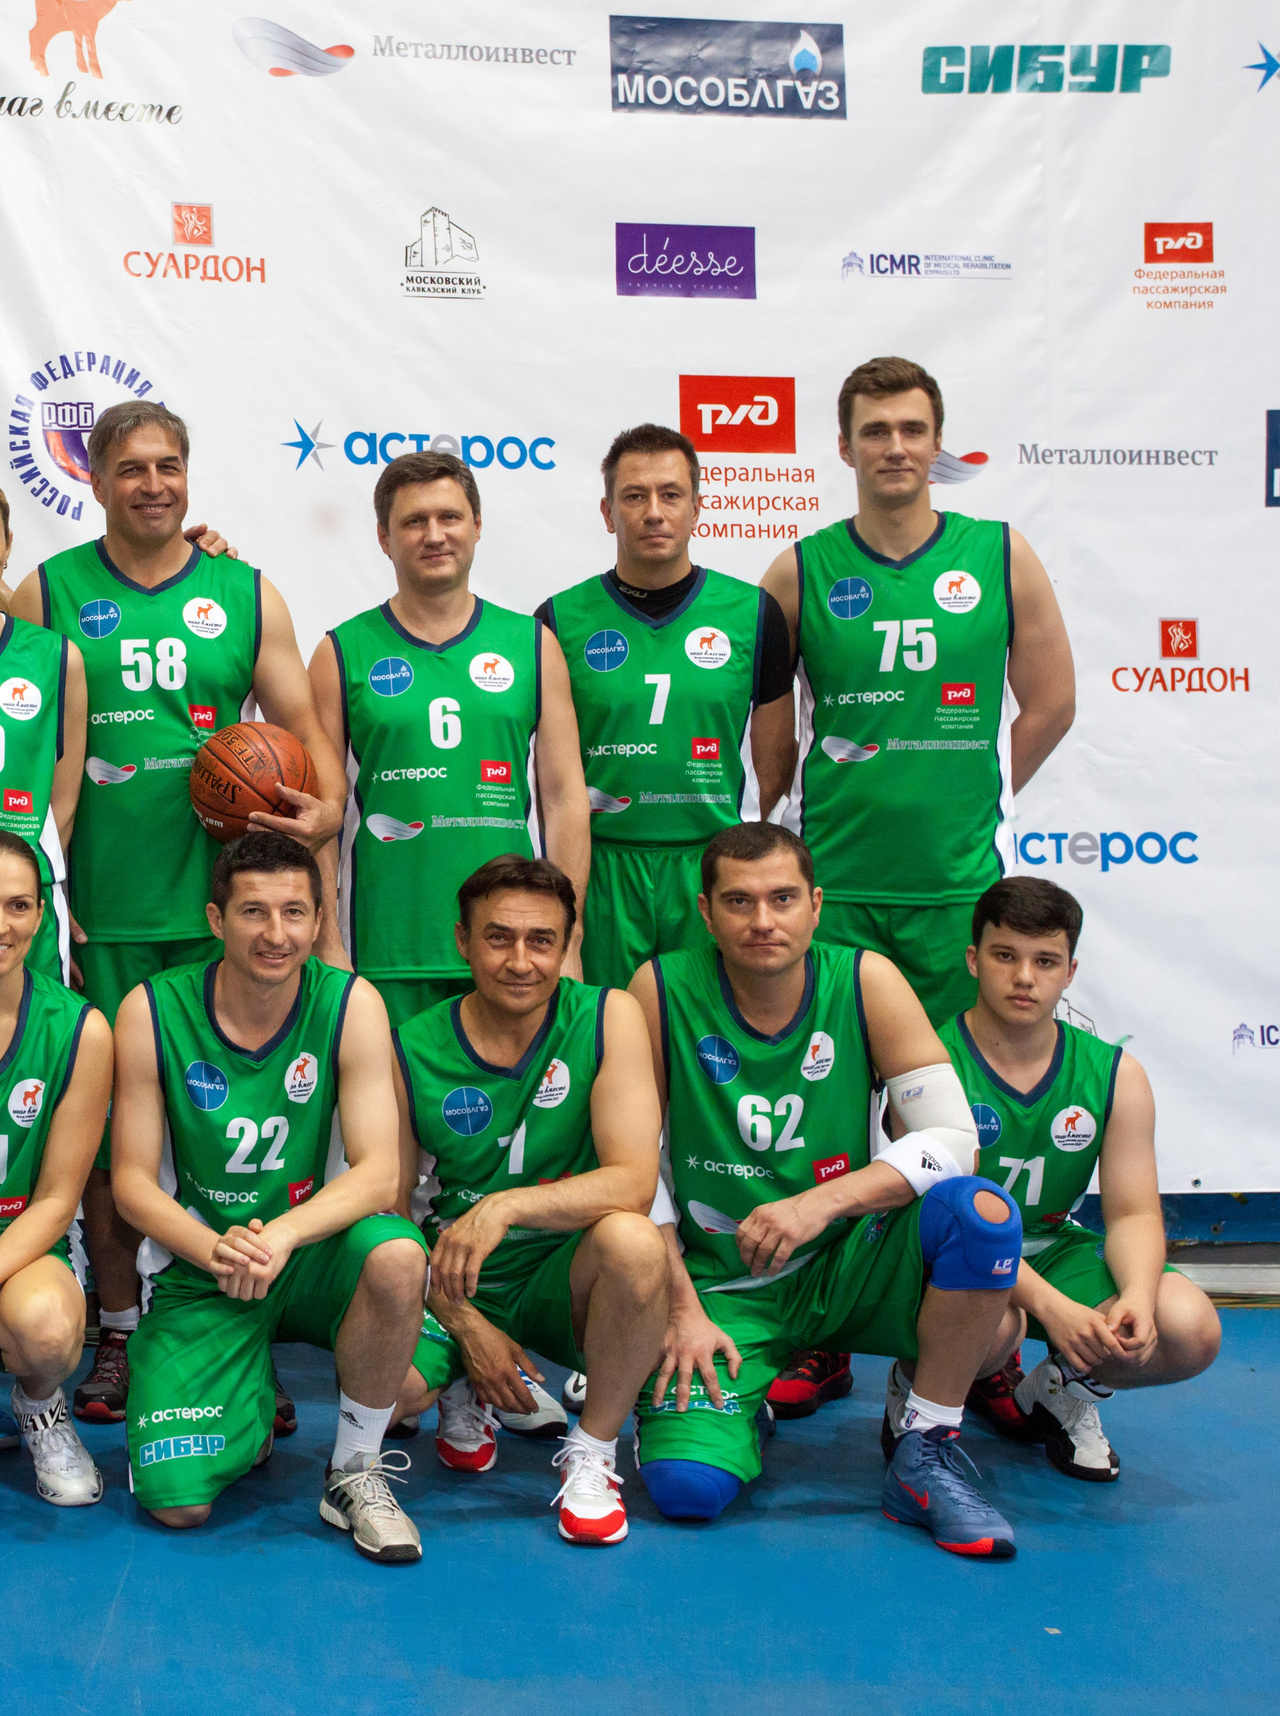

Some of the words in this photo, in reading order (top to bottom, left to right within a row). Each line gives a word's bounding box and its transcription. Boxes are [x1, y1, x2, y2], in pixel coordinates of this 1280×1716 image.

[371, 34, 577, 67] Металлоинвест
[920, 43, 1173, 96] СИБУР
[53, 80, 183, 126] вместе
[122, 250, 266, 284] СУАРДОН
[627, 233, 745, 277] déesse
[869, 254, 921, 275] ICMR
[924, 254, 973, 262] INTERNATIONAL
[963, 262, 1012, 270] REHABILITATION
[405, 275, 481, 286] МОСКОВСКИЙ
[1133, 268, 1226, 282] Федеральная
[405, 286, 458, 294] КАВКАЗСКИЙ
[1132, 284, 1228, 297] пассажирская
[1146, 299, 1214, 310] компания
[29, 350, 154, 399] ФЕДЕРАЦИЯ
[40, 402, 95, 429] РФБ
[8, 393, 84, 522] РОССИЙСКАЯ
[1018, 442, 1219, 468] Металлоинвест
[698, 465, 816, 488] деральная
[699, 494, 820, 517] сажирская
[873, 618, 937, 672] 75
[120, 637, 187, 692] 58
[1111, 666, 1250, 694] СУАРДОН
[644, 673, 671, 725] 7
[838, 690, 905, 706] астерос
[935, 706, 980, 715] Федеральная
[91, 709, 155, 725] астерос
[429, 697, 462, 750] 6
[934, 714, 980, 723] пассажирская
[381, 767, 448, 782] астерос
[1015, 831, 1200, 873] стерос
[1260, 1024, 1280, 1046] IC
[737, 1093, 805, 1152] 62
[225, 1115, 289, 1174] 22
[497, 1118, 527, 1175] 1
[703, 1157, 775, 1181] астерос
[998, 1155, 1046, 1206] 71
[993, 1258, 1013, 1270] LP
[151, 1405, 224, 1424] астерос
[139, 1434, 226, 1468] СИБУР
